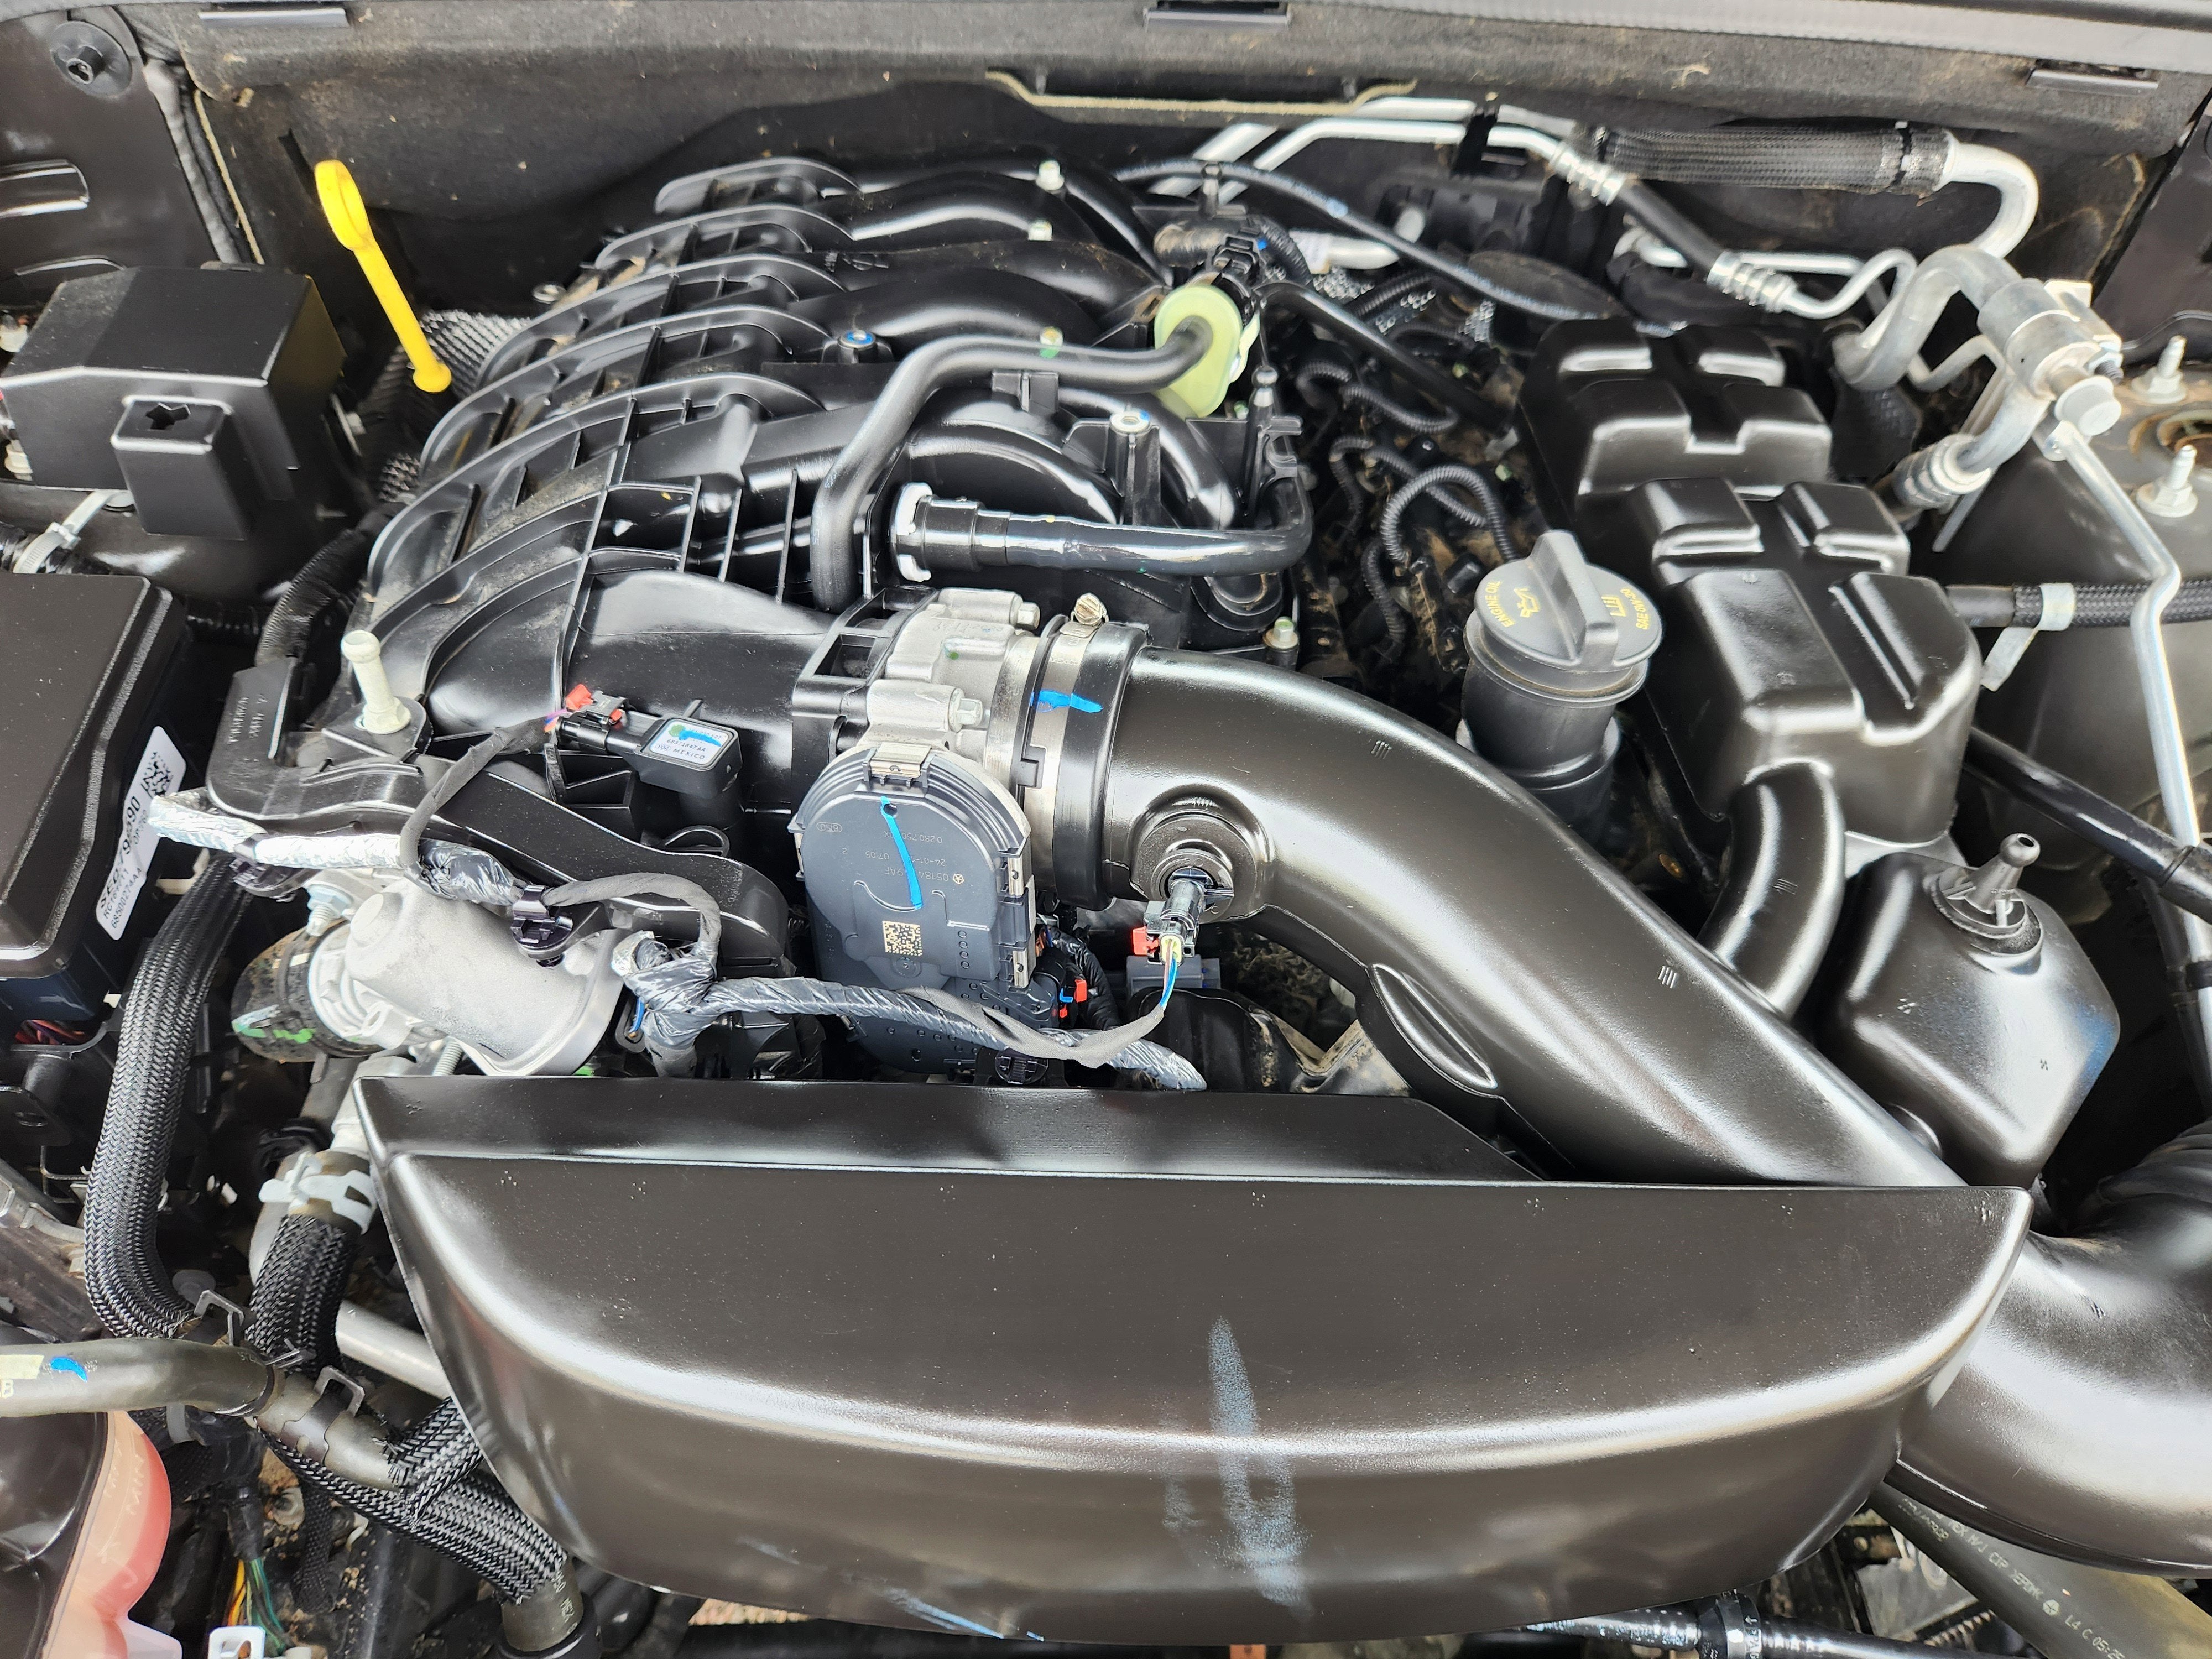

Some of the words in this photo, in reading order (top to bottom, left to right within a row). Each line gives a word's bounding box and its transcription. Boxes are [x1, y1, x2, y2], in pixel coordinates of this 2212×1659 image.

[1485, 581, 1501, 593] OIL
[1620, 588, 1646, 612] 0W-20
[1485, 595, 1514, 627] ENGINE
[1636, 612, 1650, 630] SAE
[673, 748, 705, 760] MEXICO
[2065, 1614, 2080, 1631] L4
